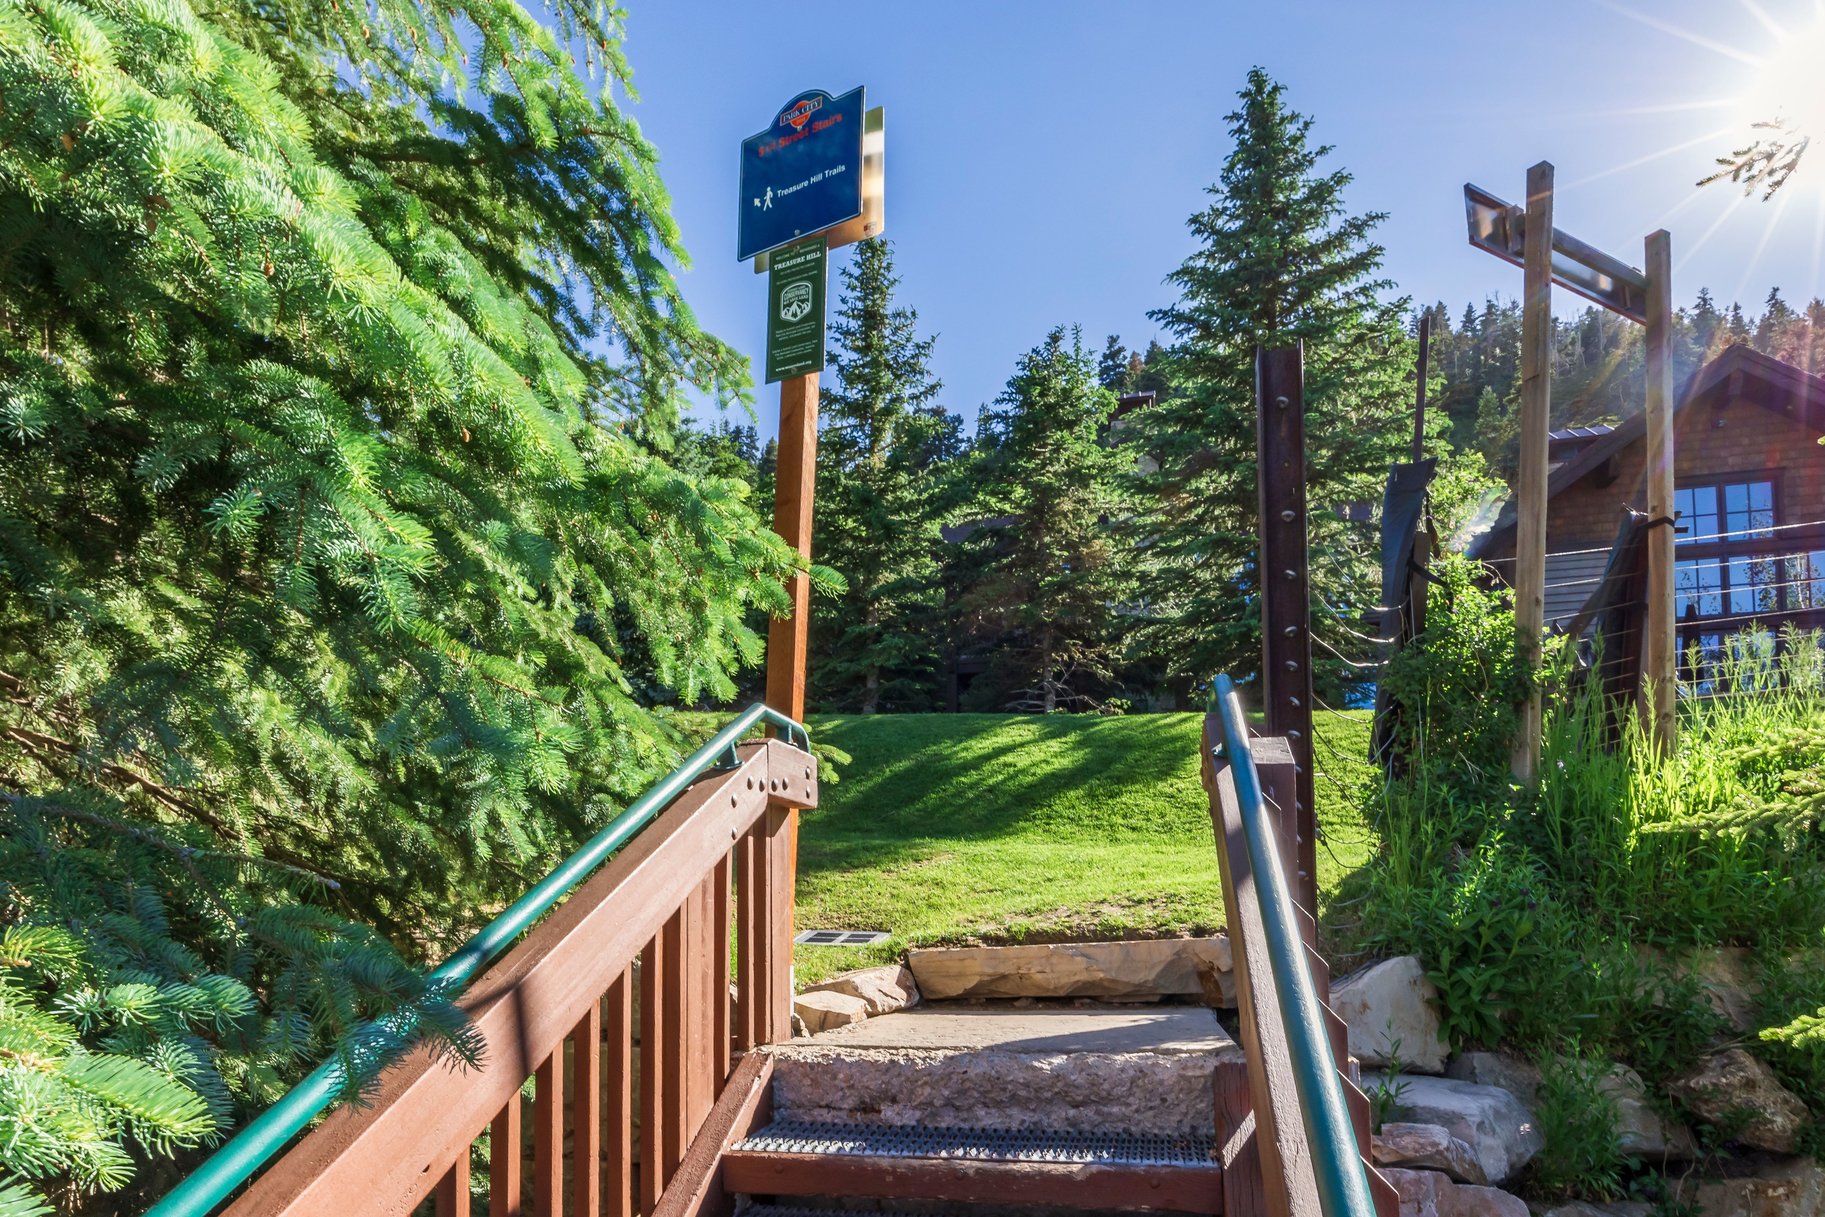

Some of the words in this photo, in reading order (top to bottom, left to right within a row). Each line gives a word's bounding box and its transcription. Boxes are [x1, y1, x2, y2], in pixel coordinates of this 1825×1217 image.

[783, 109, 800, 122] PARK
[812, 113, 843, 133] Stairs
[777, 180, 809, 198] Treasure
[810, 172, 823, 185] Hill
[824, 164, 846, 179] Trails
[773, 256, 806, 271] TREASURE
[806, 251, 822, 261] HILL
